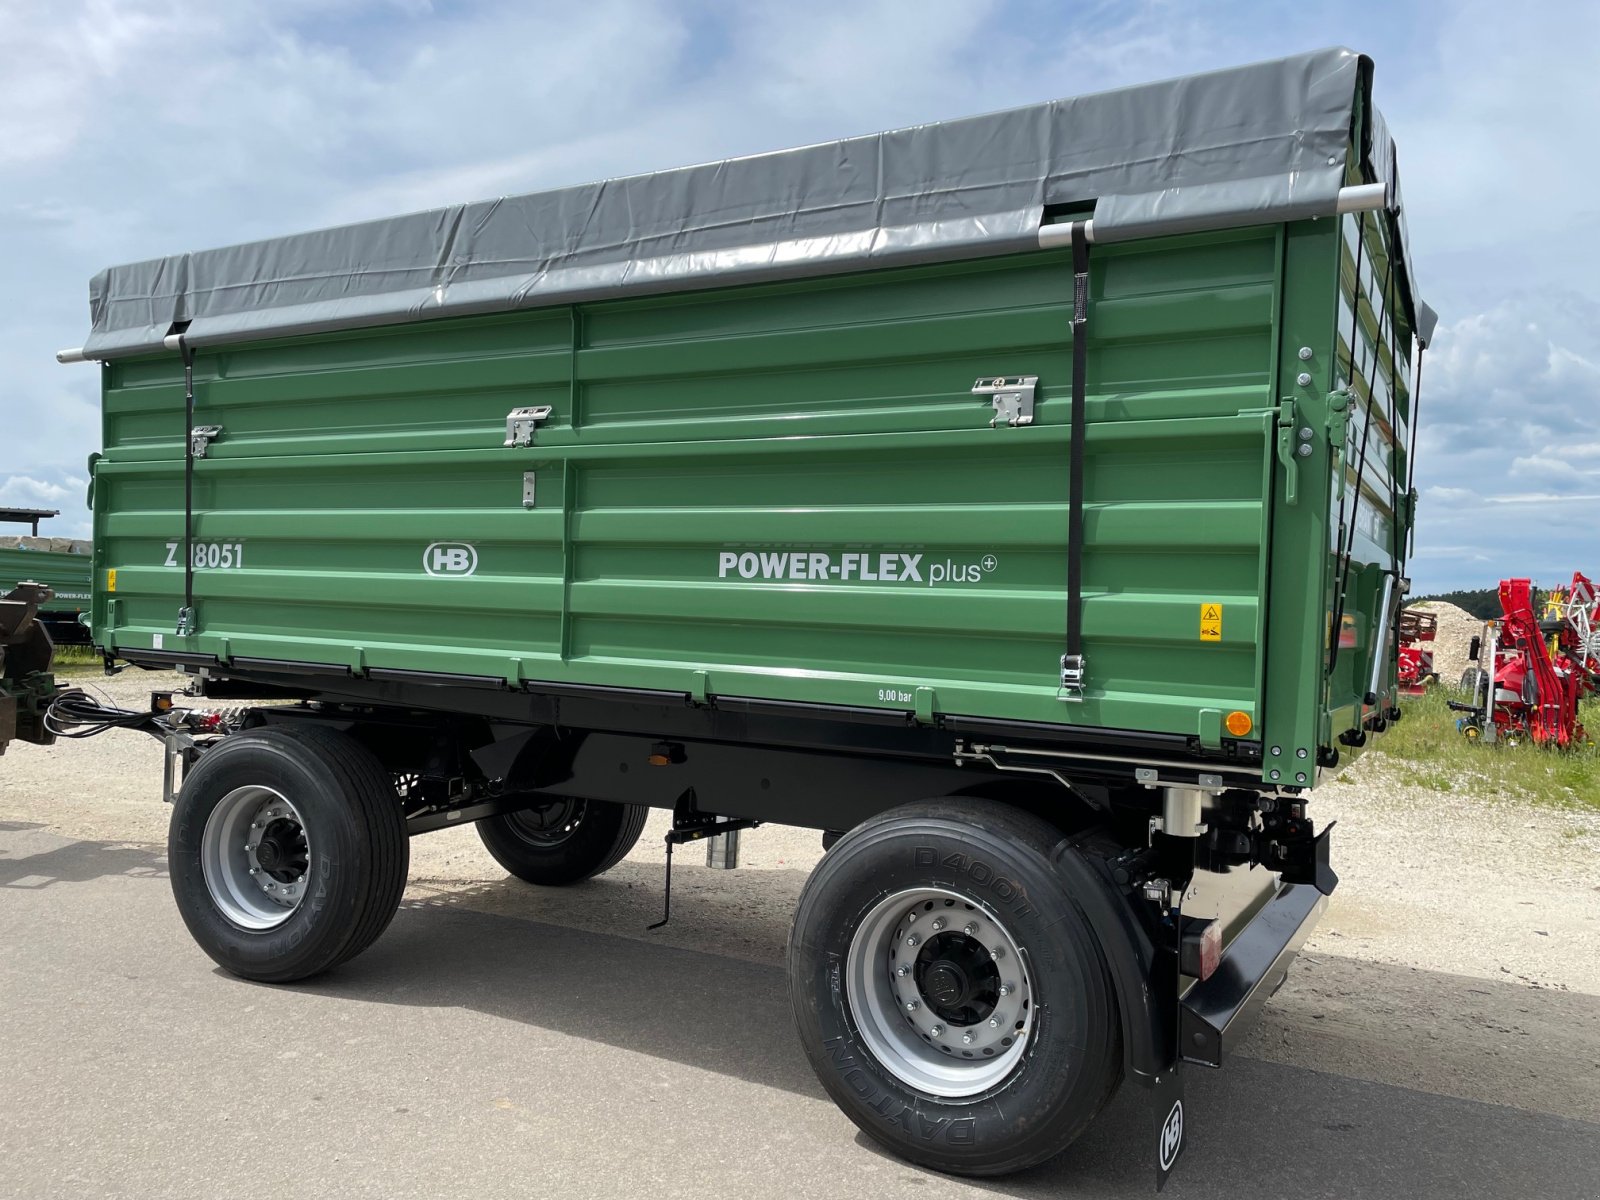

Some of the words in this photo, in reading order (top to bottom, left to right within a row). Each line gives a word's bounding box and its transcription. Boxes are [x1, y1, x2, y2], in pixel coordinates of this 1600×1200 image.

[164, 543, 178, 566] Z
[718, 552, 923, 582] POWER-FLEX
[878, 689, 896, 703] 9,00
[898, 690, 912, 702] bar
[824, 1034, 977, 1146] DAYTON
